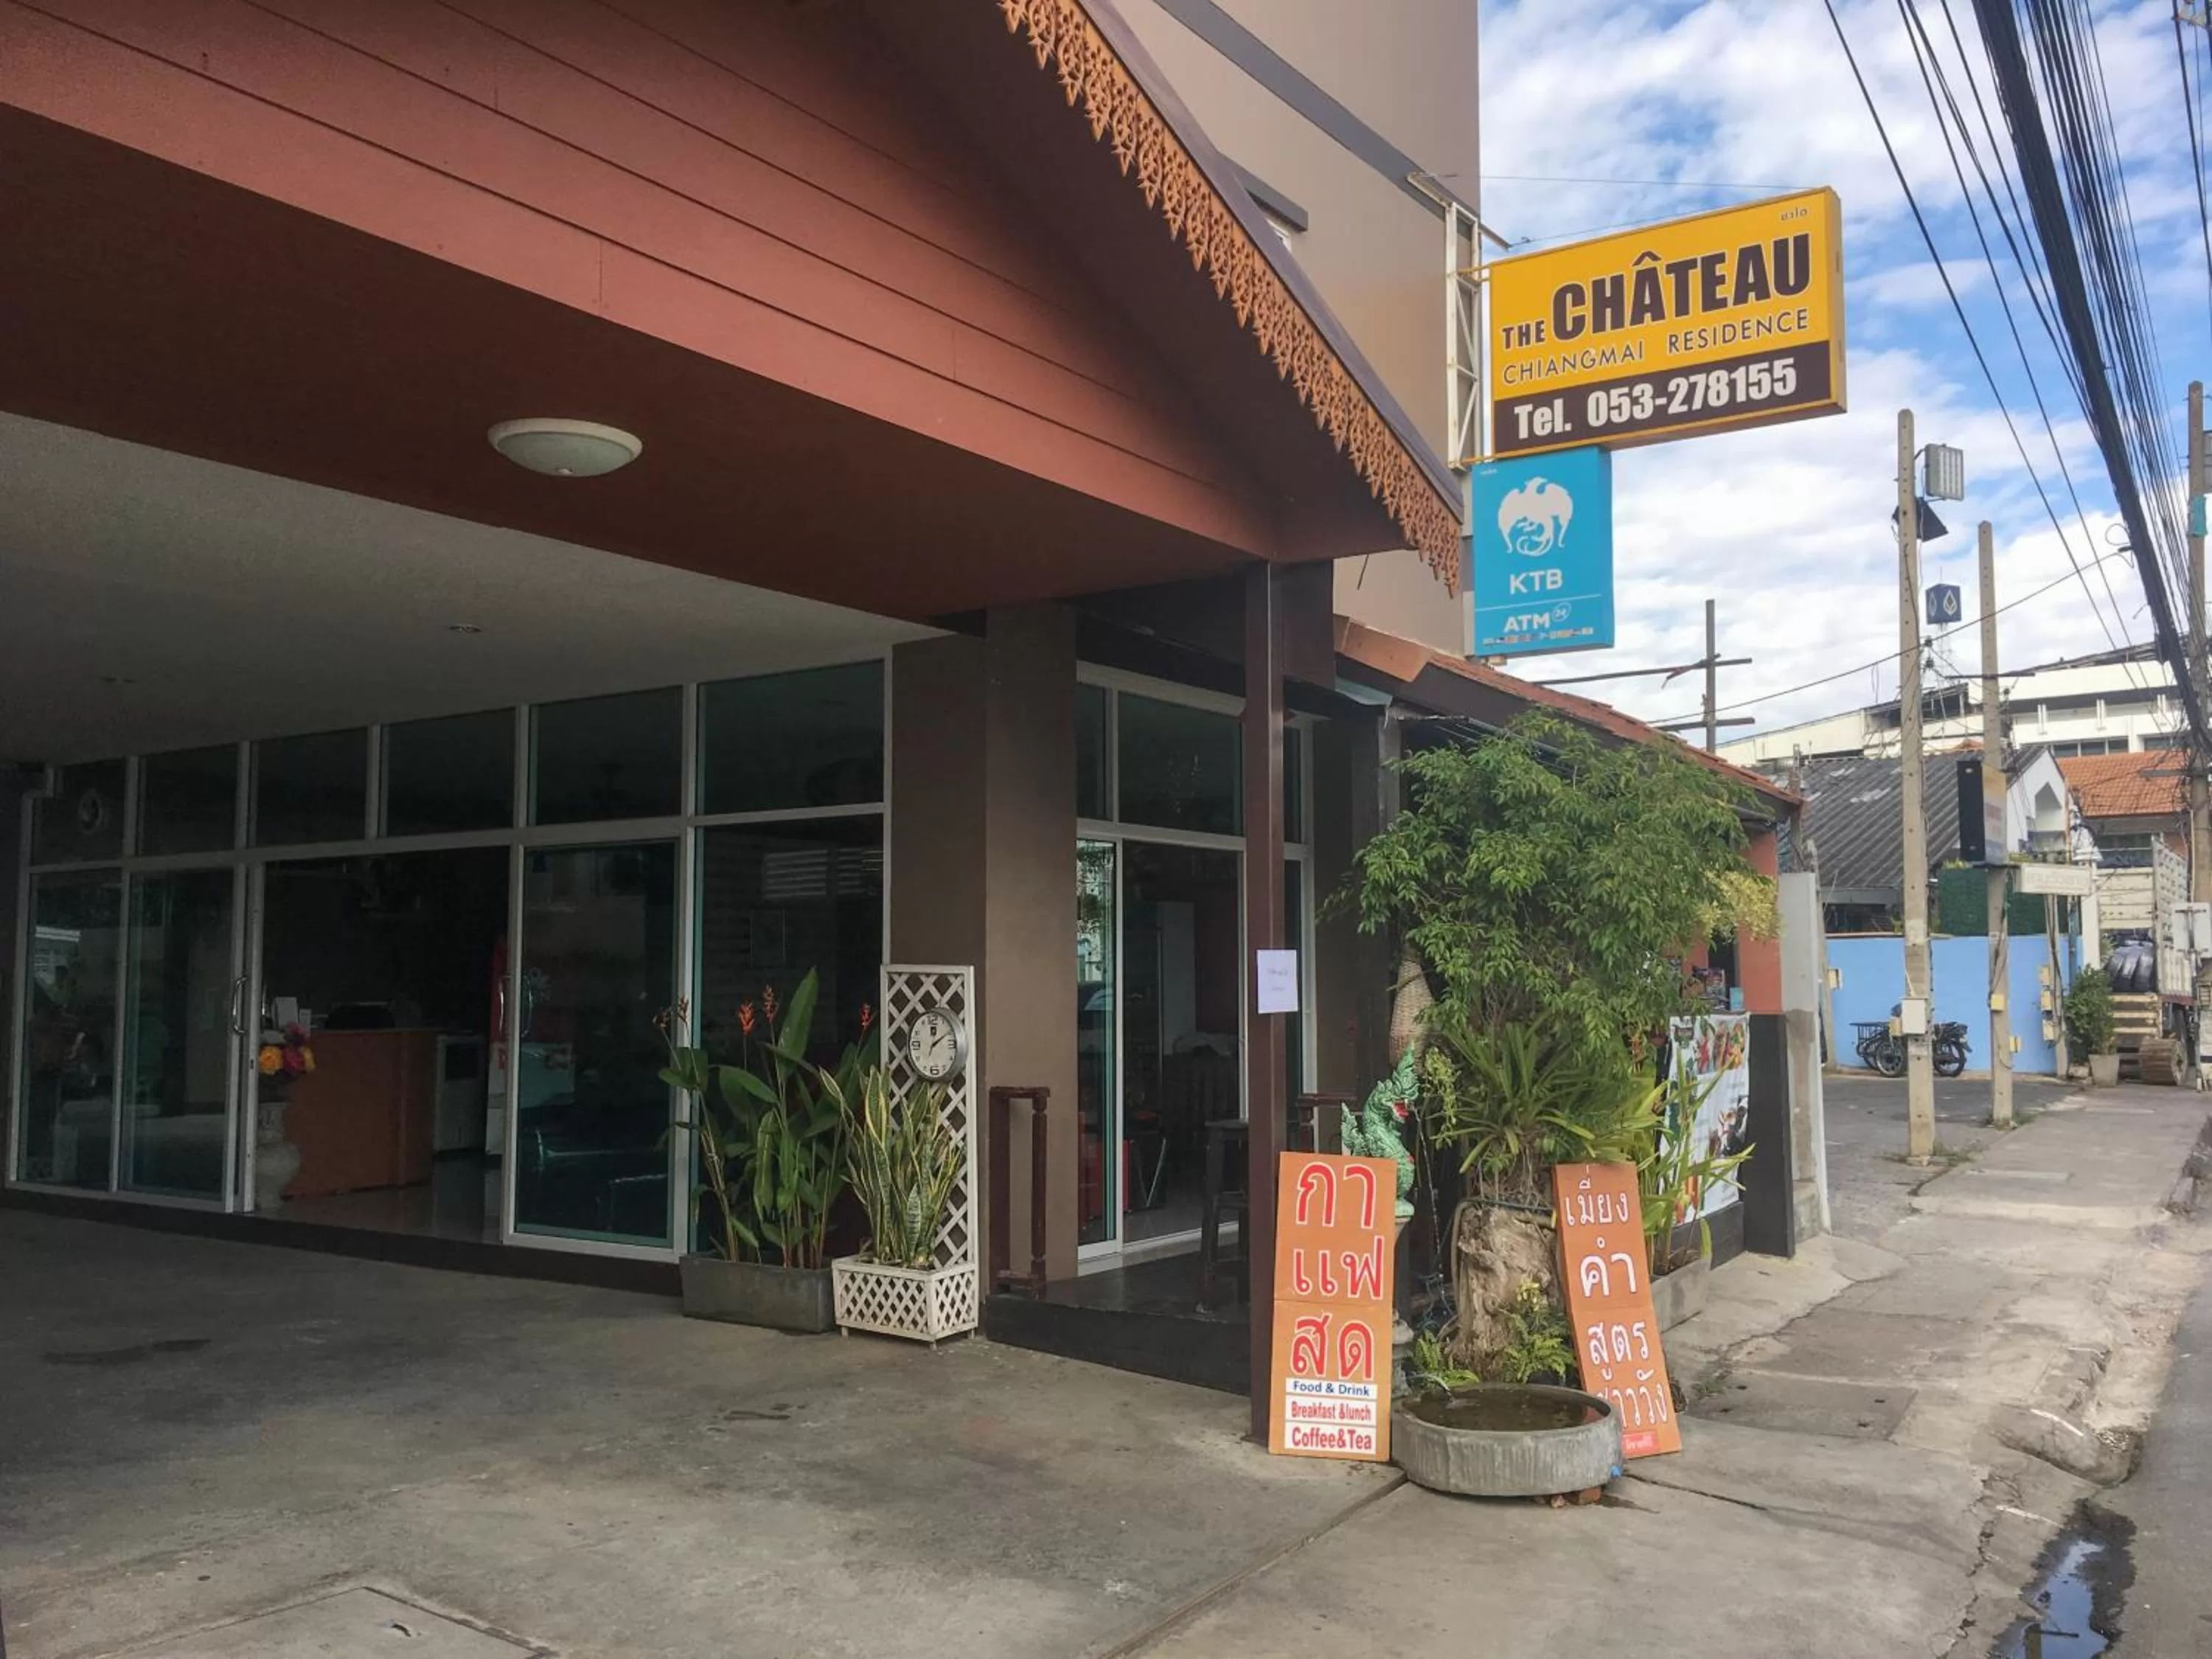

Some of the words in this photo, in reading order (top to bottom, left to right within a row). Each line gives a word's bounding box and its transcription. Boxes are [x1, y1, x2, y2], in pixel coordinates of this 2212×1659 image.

[1501, 319, 1545, 351] THE
[1552, 233, 1811, 341] CHÂTEAU
[1503, 341, 1645, 386] CHIANGMAI
[1668, 308, 1809, 355] RESIDENCE
[1514, 403, 1572, 439] Tel.
[1587, 357, 1797, 429] 053-278155
[1509, 568, 1563, 595] KTB
[1503, 613, 1551, 633] ATM
[1295, 1161, 1377, 1229] กา
[1293, 1235, 1385, 1300] แฟ
[1291, 1312, 1374, 1381] สด
[1587, 1321, 1649, 1381] สูตร
[1290, 1401, 1336, 1419] Breakfast
[1338, 1402, 1371, 1422] &lunch
[1293, 1380, 1322, 1393] Food
[1325, 1382, 1335, 1394] &
[1338, 1383, 1370, 1397] Drink
[1292, 1426, 1372, 1450] Coffee&Tea
